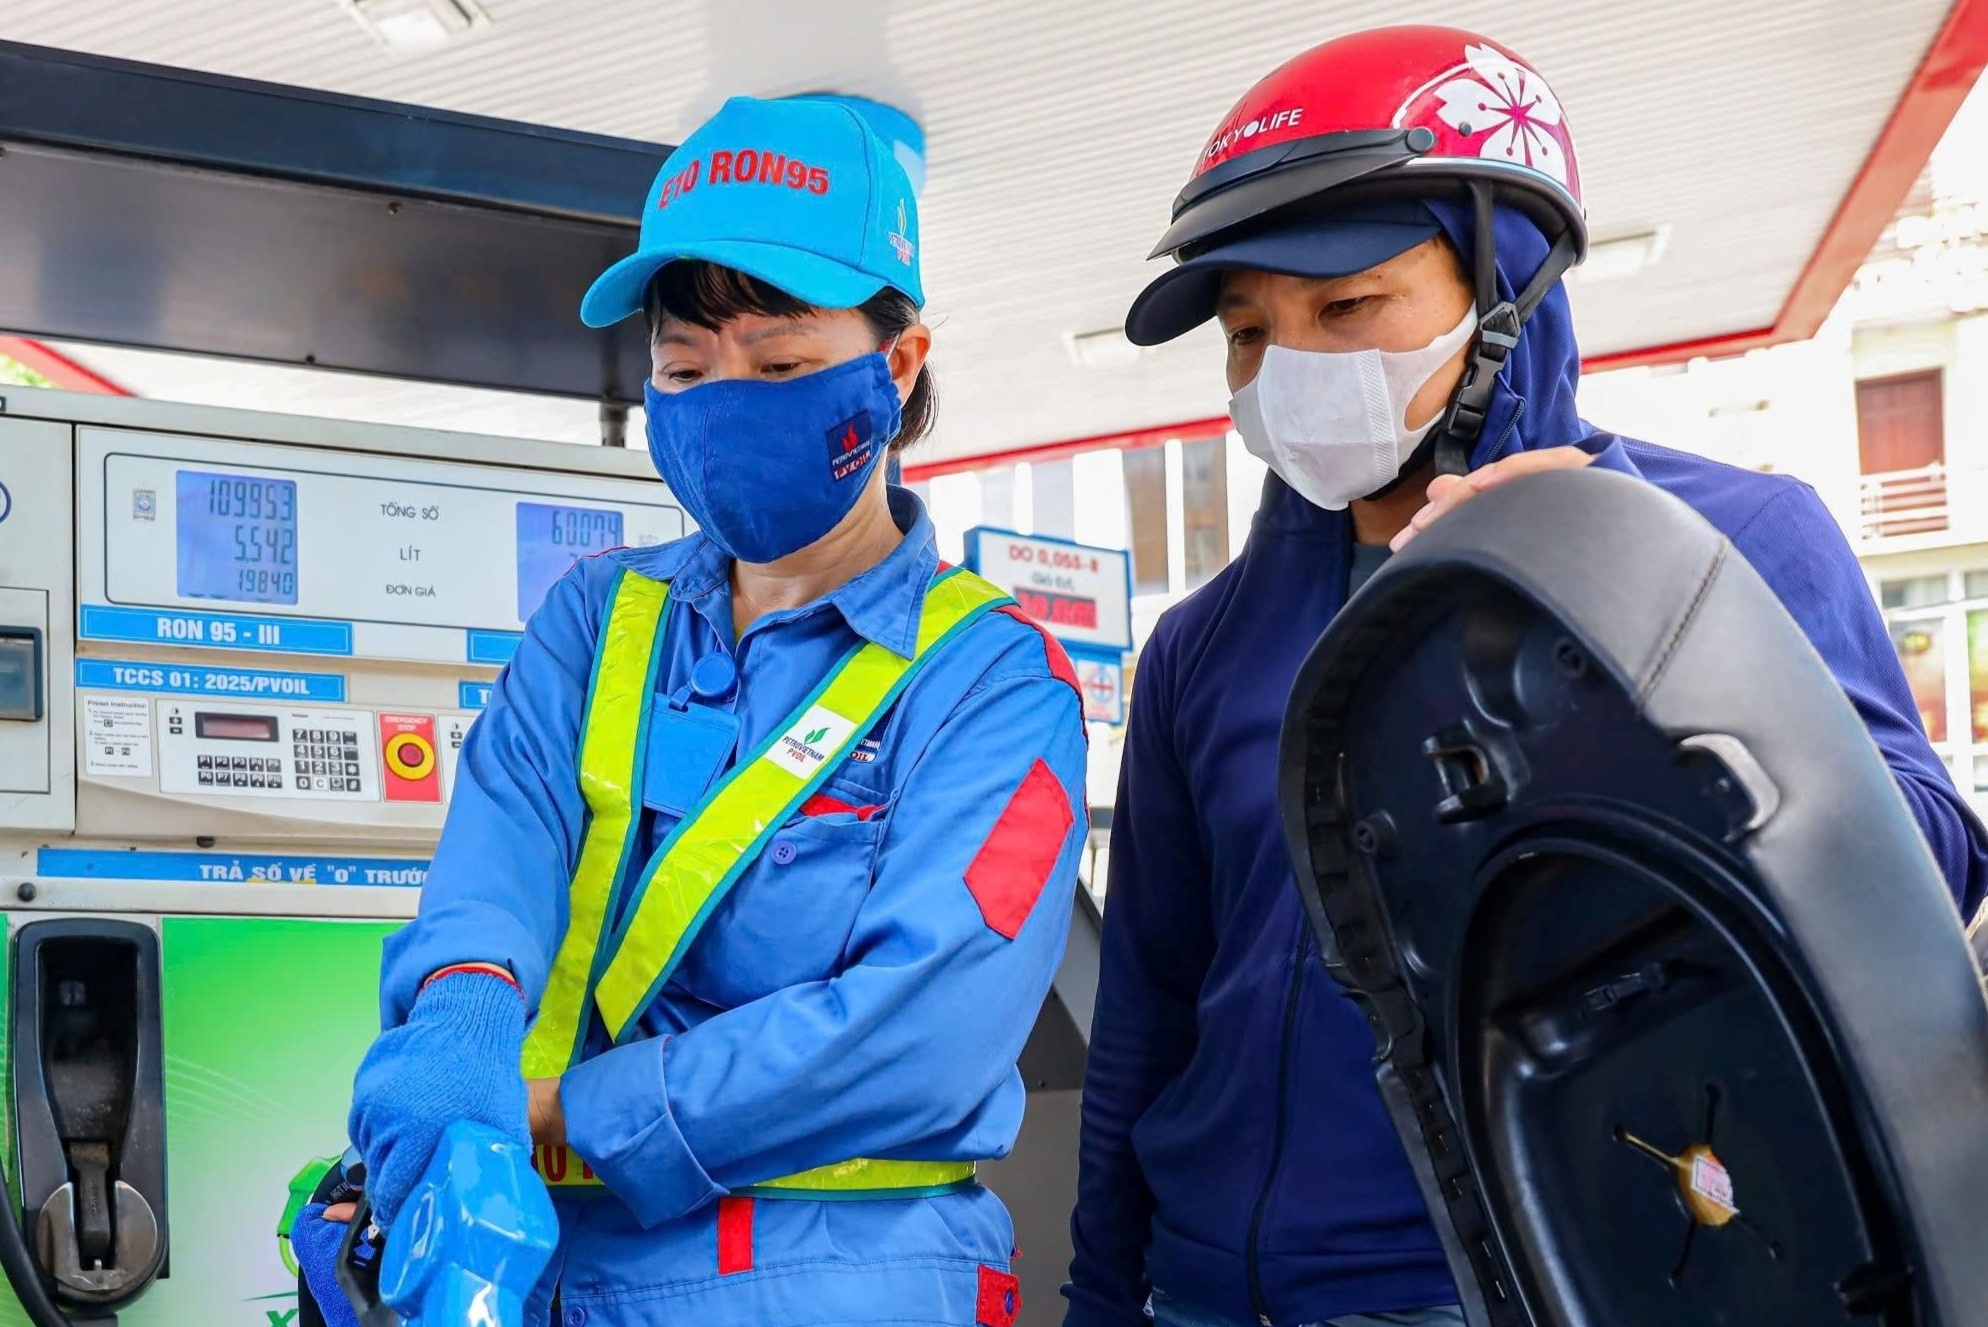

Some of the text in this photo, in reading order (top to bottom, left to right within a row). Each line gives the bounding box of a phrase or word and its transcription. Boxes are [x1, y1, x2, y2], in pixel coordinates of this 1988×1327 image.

[658, 150, 829, 210] E10 RON95
[209, 478, 294, 522] 109953
[421, 504, 439, 520] SỐ
[400, 544, 421, 561] LÍT
[1010, 545, 1033, 561] DO
[238, 569, 294, 595] 19840
[386, 584, 437, 598] ĐƠN GIÁ
[157, 617, 204, 641] RON
[210, 619, 237, 643] 95
[258, 624, 281, 645] III
[113, 667, 311, 695] TCCS 01: 2025/PVOIL
[295, 729, 304, 738] 7
[312, 731, 321, 740] 8
[329, 731, 338, 740] 9
[297, 745, 306, 753] 4
[314, 746, 322, 755] 5
[331, 747, 339, 756] 6
[781, 736, 825, 762] PETROVIETNAM
[786, 748, 808, 763] PVOIL
[199, 756, 210, 764] P1
[217, 757, 228, 765] P2
[299, 761, 340, 771] 1 2 3
[201, 772, 212, 780] P6
[299, 778, 308, 787] 0
[316, 779, 324, 788] C
[199, 860, 244, 879] TRẢ
[251, 862, 282, 881] SỐ
[289, 863, 316, 882] VỀ
